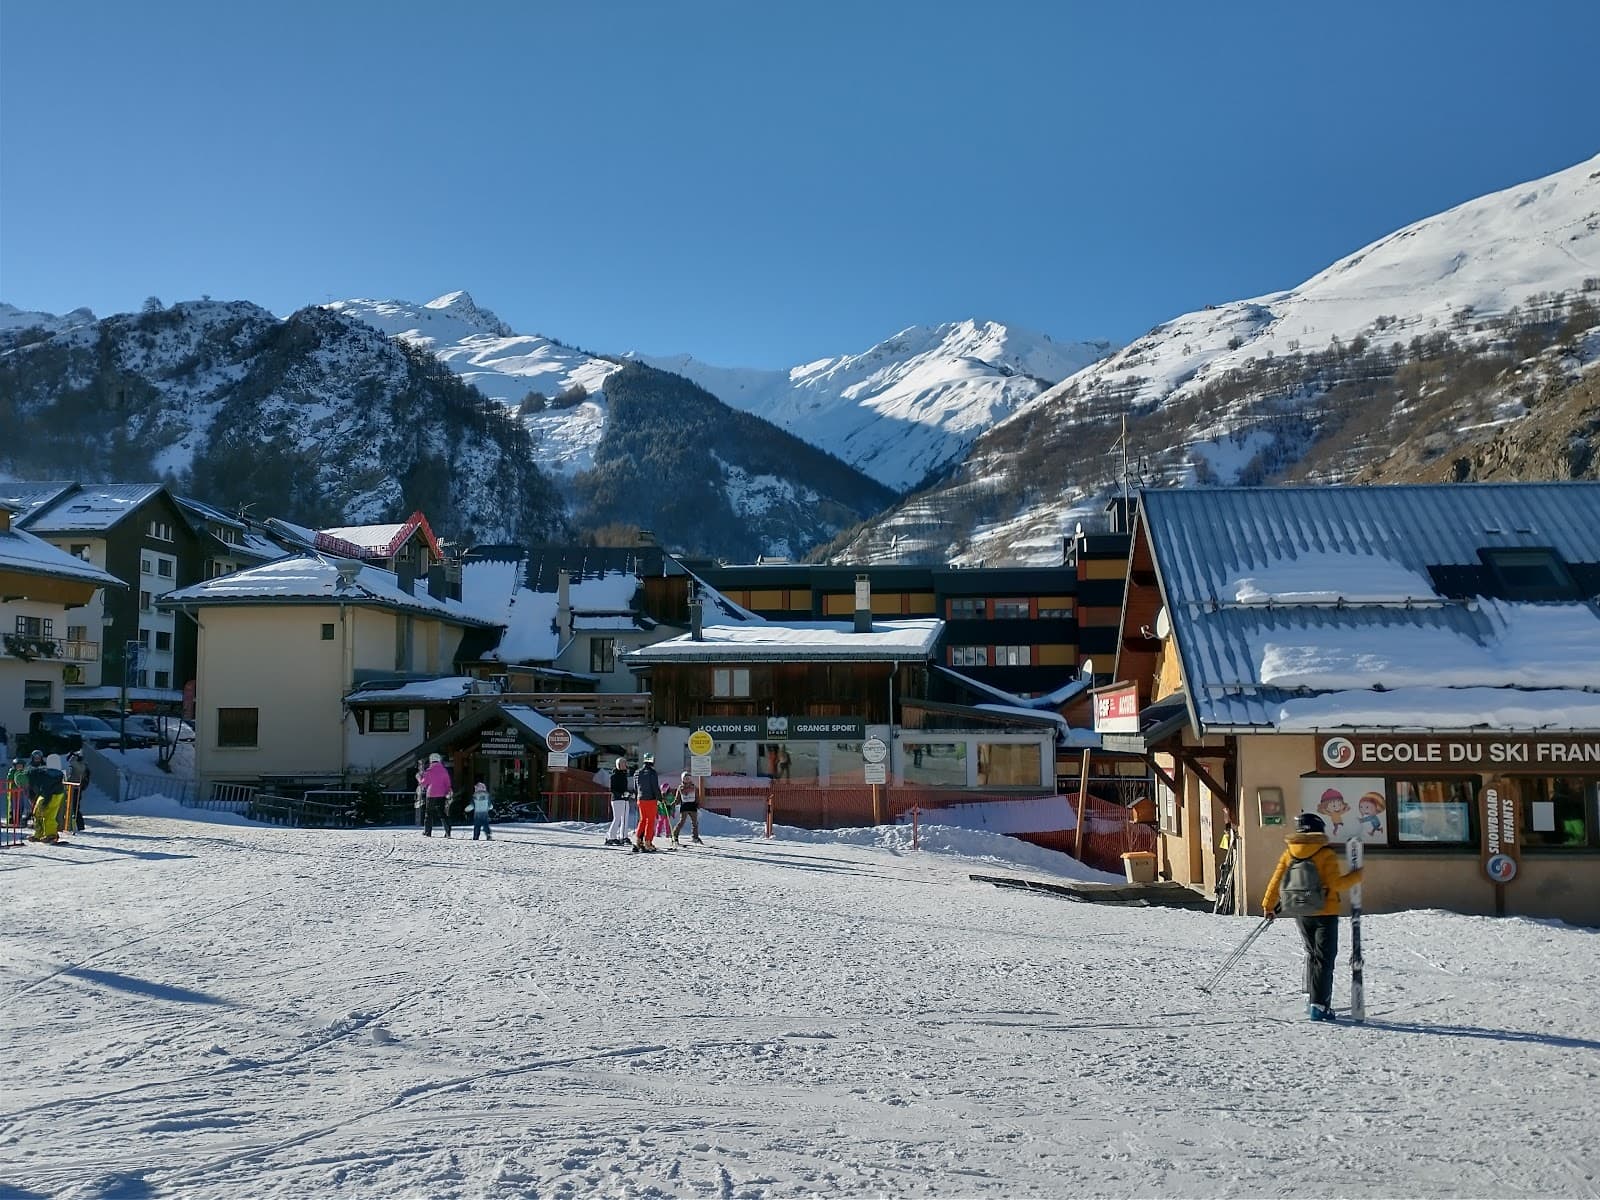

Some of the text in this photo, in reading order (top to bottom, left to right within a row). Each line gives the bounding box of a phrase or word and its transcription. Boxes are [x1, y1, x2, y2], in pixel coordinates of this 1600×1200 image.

[796, 724, 857, 732] GRANGE SPORT
[1361, 743, 1600, 762] ECOLE DU SKI FRAN
[1487, 788, 1500, 854] SNOWBOARD
[1503, 799, 1515, 844] ENFANTS
